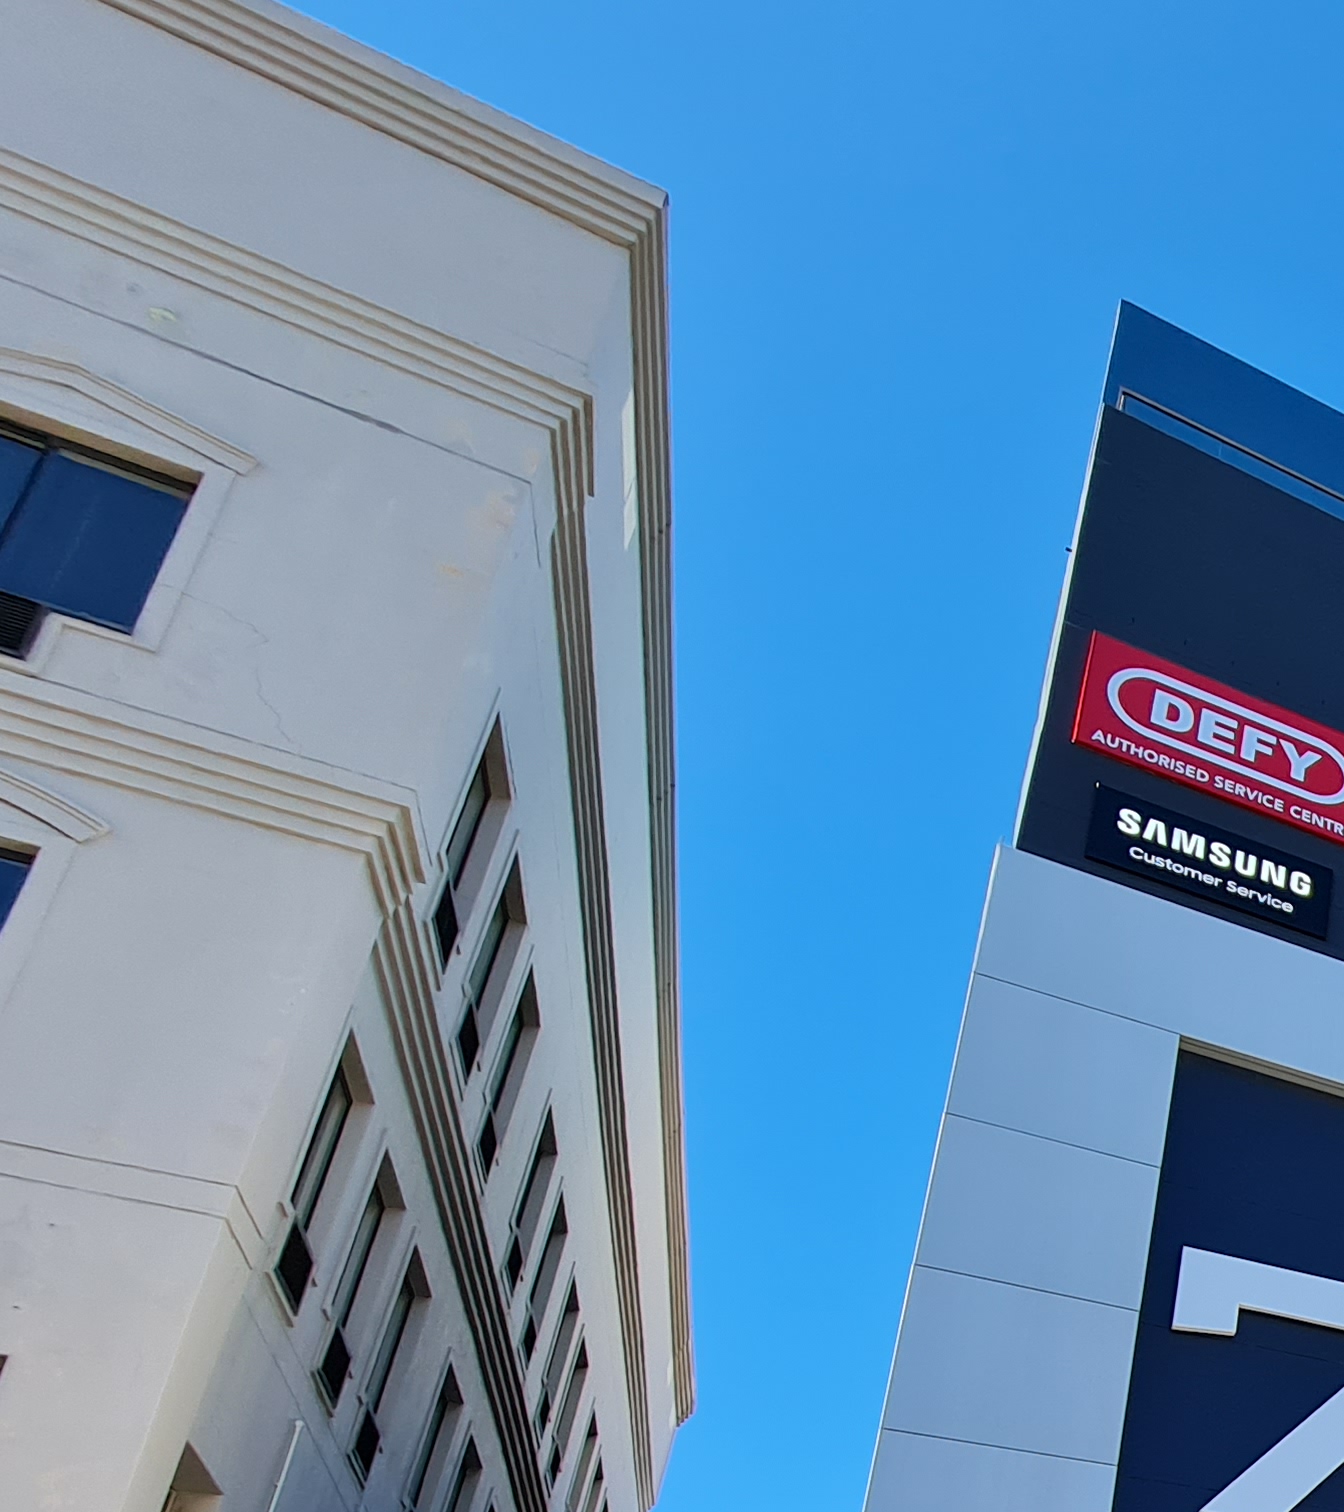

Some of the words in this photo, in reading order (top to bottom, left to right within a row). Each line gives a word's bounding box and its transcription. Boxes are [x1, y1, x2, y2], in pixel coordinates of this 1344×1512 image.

[1091, 729, 1210, 783] AUTHORISED
[1213, 775, 1285, 812] SERVICE
[1150, 688, 1323, 783] DEFY
[1116, 807, 1313, 898] SAMSUNG
[1129, 846, 1222, 889] Customer
[1226, 880, 1295, 914] Service
